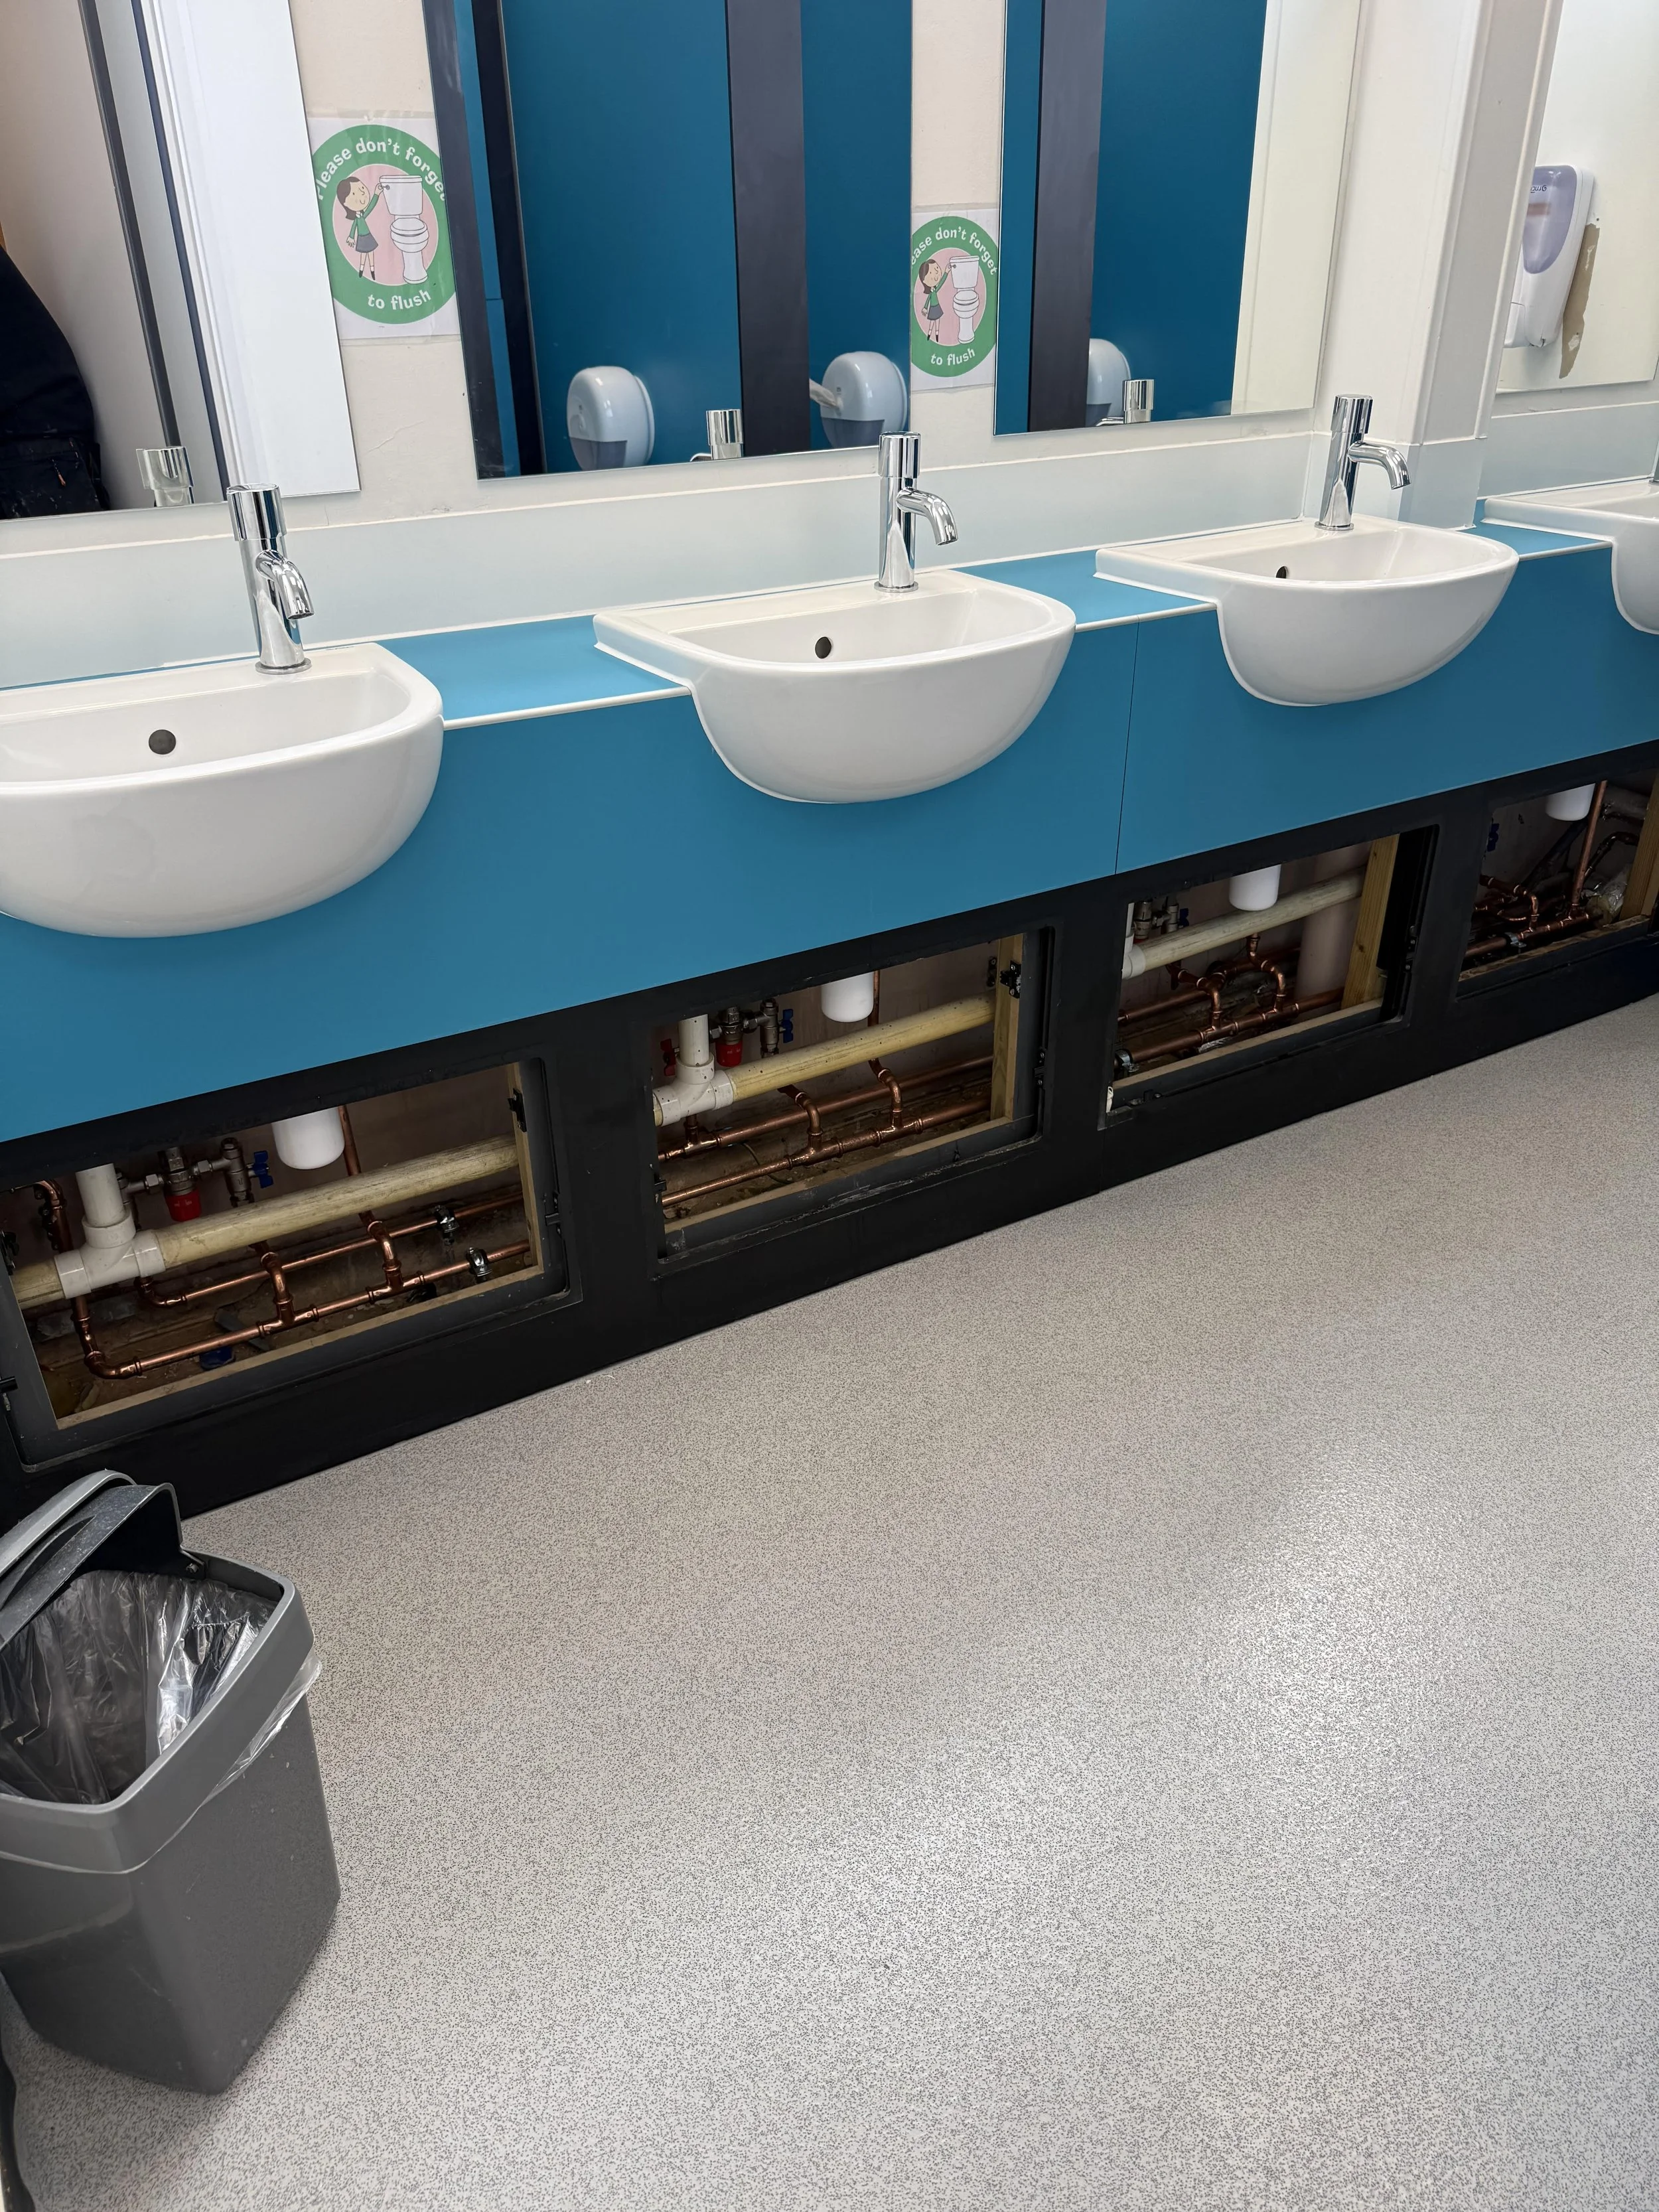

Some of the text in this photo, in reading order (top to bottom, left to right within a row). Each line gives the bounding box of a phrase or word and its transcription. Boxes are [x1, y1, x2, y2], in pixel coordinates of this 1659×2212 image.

[911, 237, 932, 265] ease
[969, 232, 997, 275] forget
[368, 289, 431, 310] to flush
[930, 348, 975, 366] to flush
